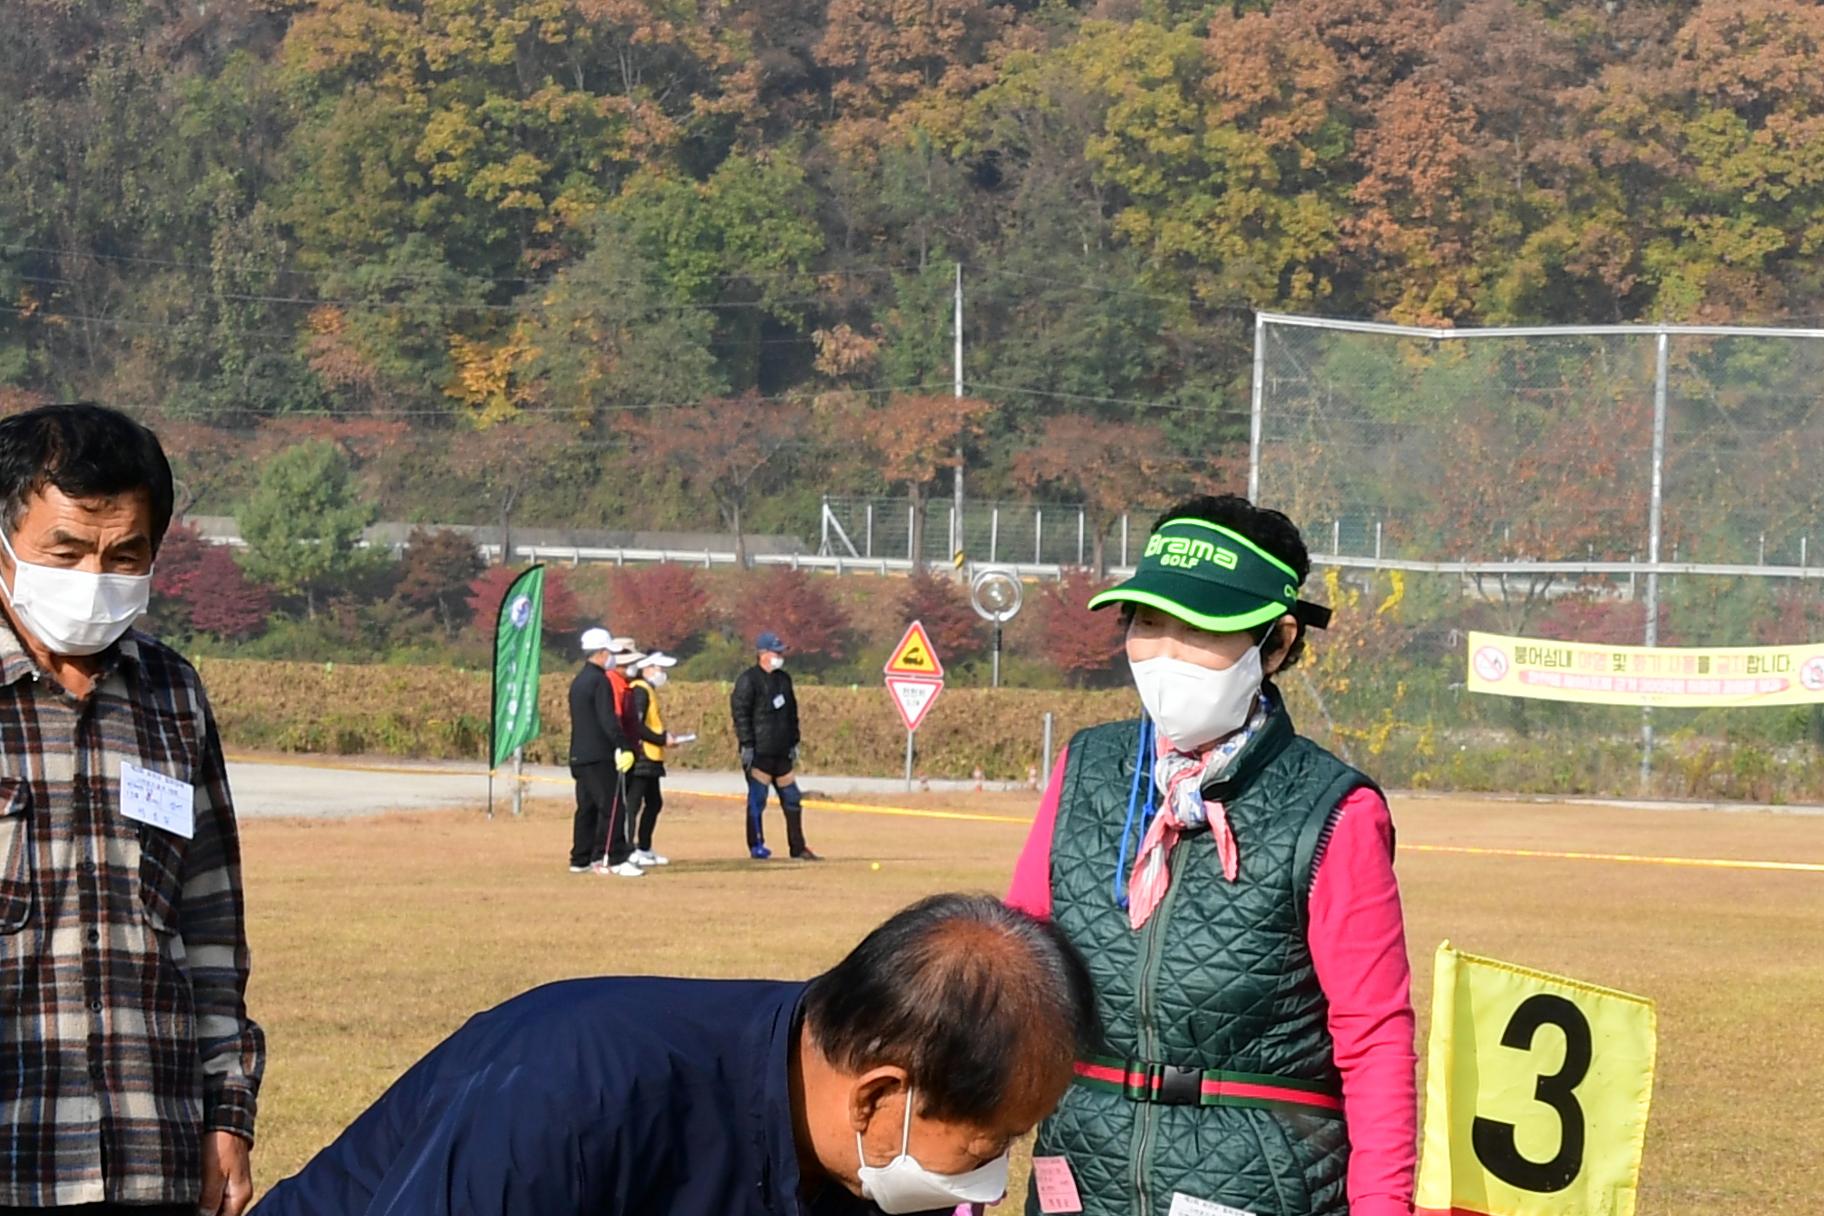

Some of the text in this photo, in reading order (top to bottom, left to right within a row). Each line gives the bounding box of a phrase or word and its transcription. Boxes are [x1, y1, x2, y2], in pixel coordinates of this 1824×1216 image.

[1144, 534, 1238, 570] Brama
[1160, 554, 1199, 569] GOLF
[1613, 653, 1626, 672] 및
[1472, 993, 1592, 1193] 3
